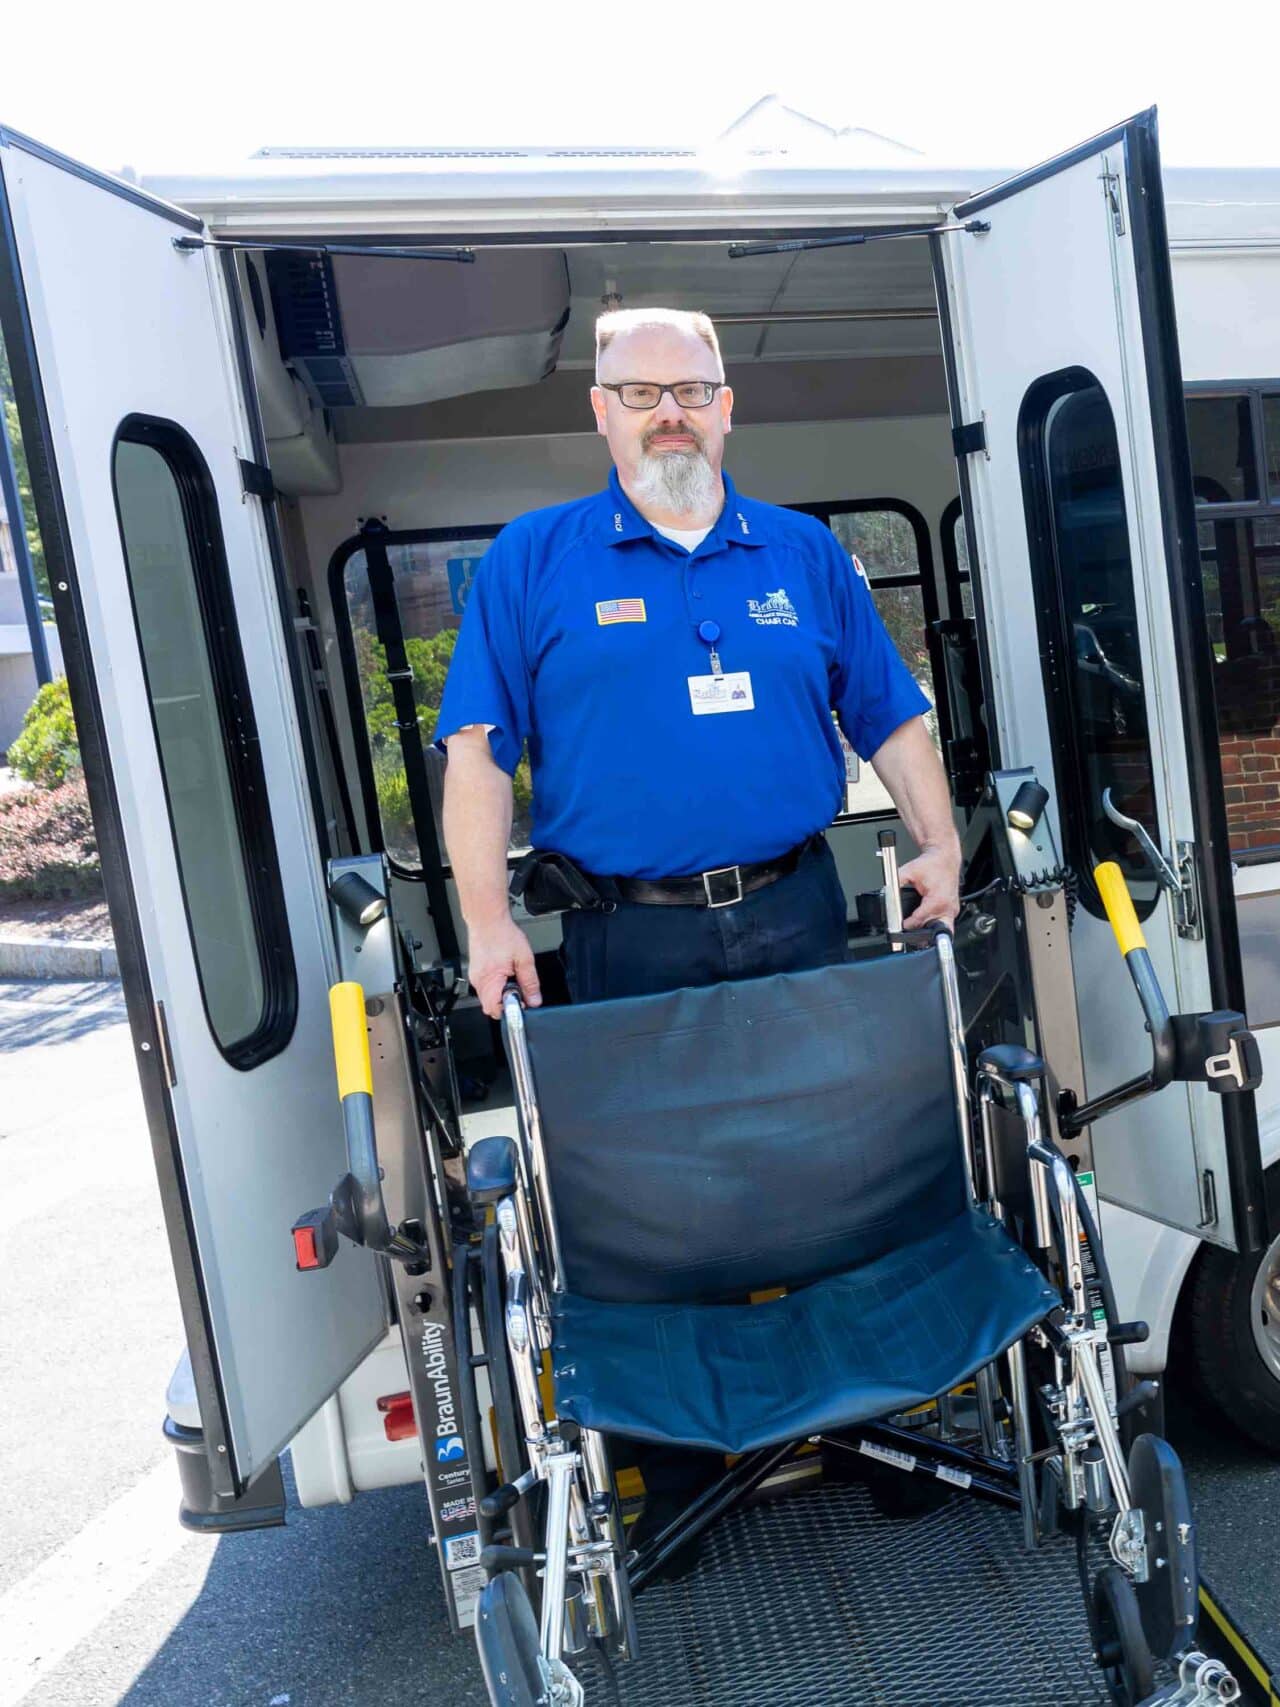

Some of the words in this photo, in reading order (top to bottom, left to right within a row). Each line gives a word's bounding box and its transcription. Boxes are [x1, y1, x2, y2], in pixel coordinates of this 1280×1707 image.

[421, 1321, 459, 1437] BraunAbility
[438, 1469, 470, 1480] Century
[443, 1498, 466, 1508] MADE
